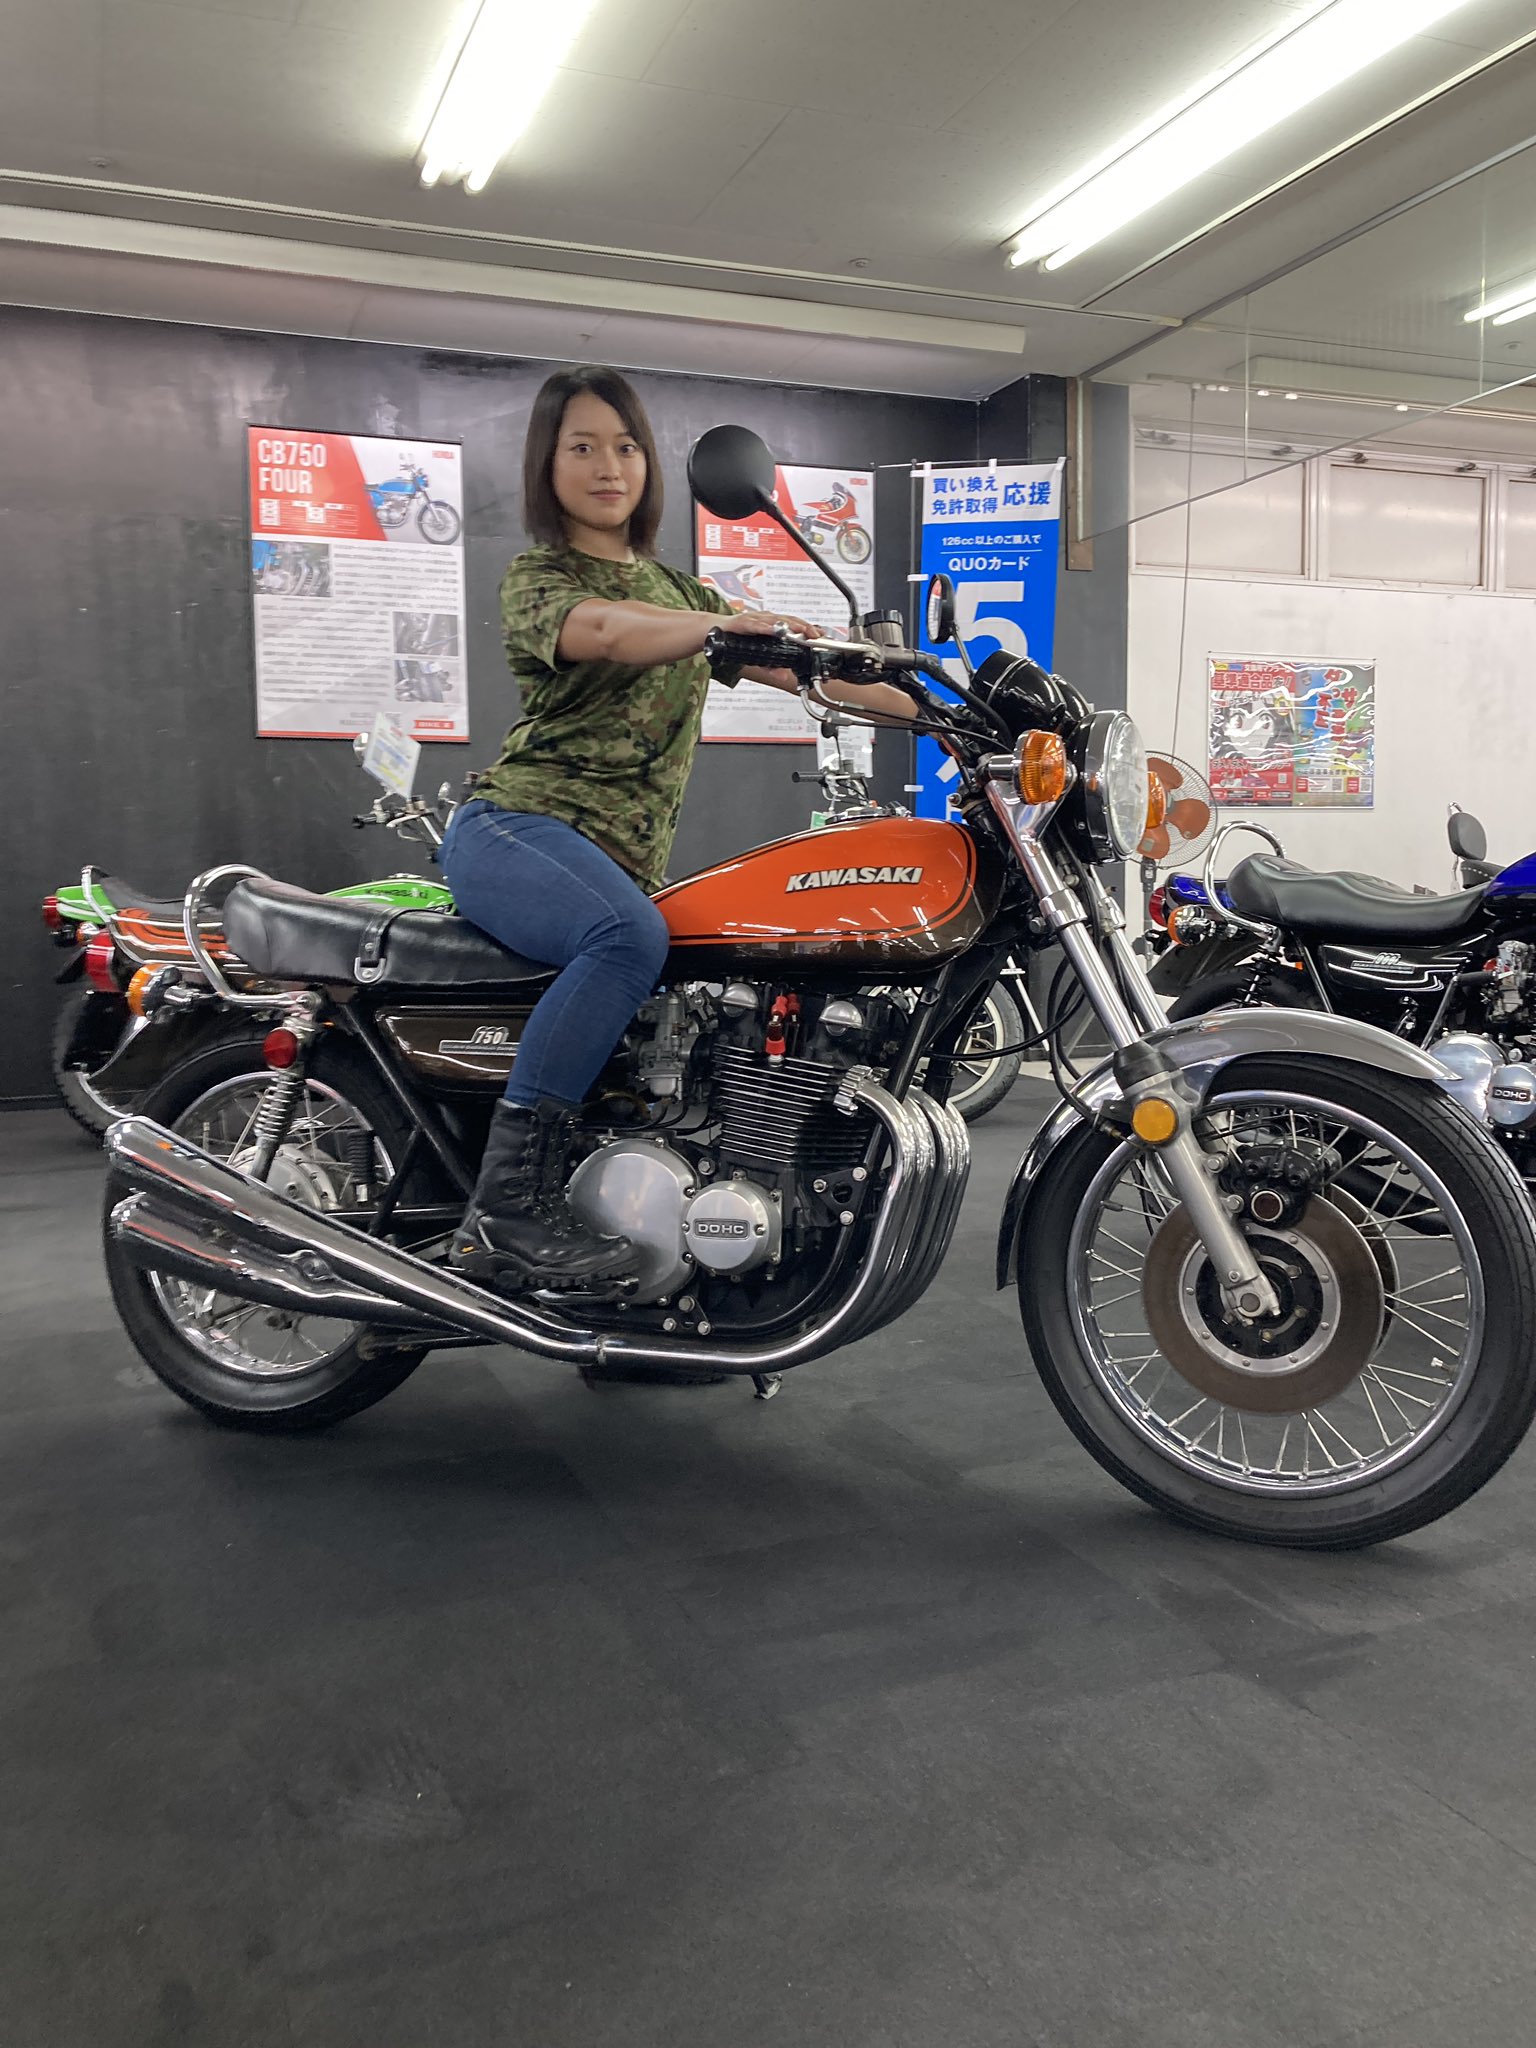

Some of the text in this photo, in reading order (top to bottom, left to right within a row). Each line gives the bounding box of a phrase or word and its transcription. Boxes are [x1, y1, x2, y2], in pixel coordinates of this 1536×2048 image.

[257, 439, 327, 468] CB750
[258, 467, 314, 494] FOUR
[932, 476, 999, 494] 買い換え
[1002, 480, 1053, 507] 応援
[931, 497, 999, 516] 免許取得
[948, 556, 1031, 572] QUOカード
[785, 865, 923, 894] KAWASAKI
[475, 1030, 504, 1045] 750
[1494, 1089, 1527, 1100] DOHC
[697, 1223, 745, 1235] DOHC
